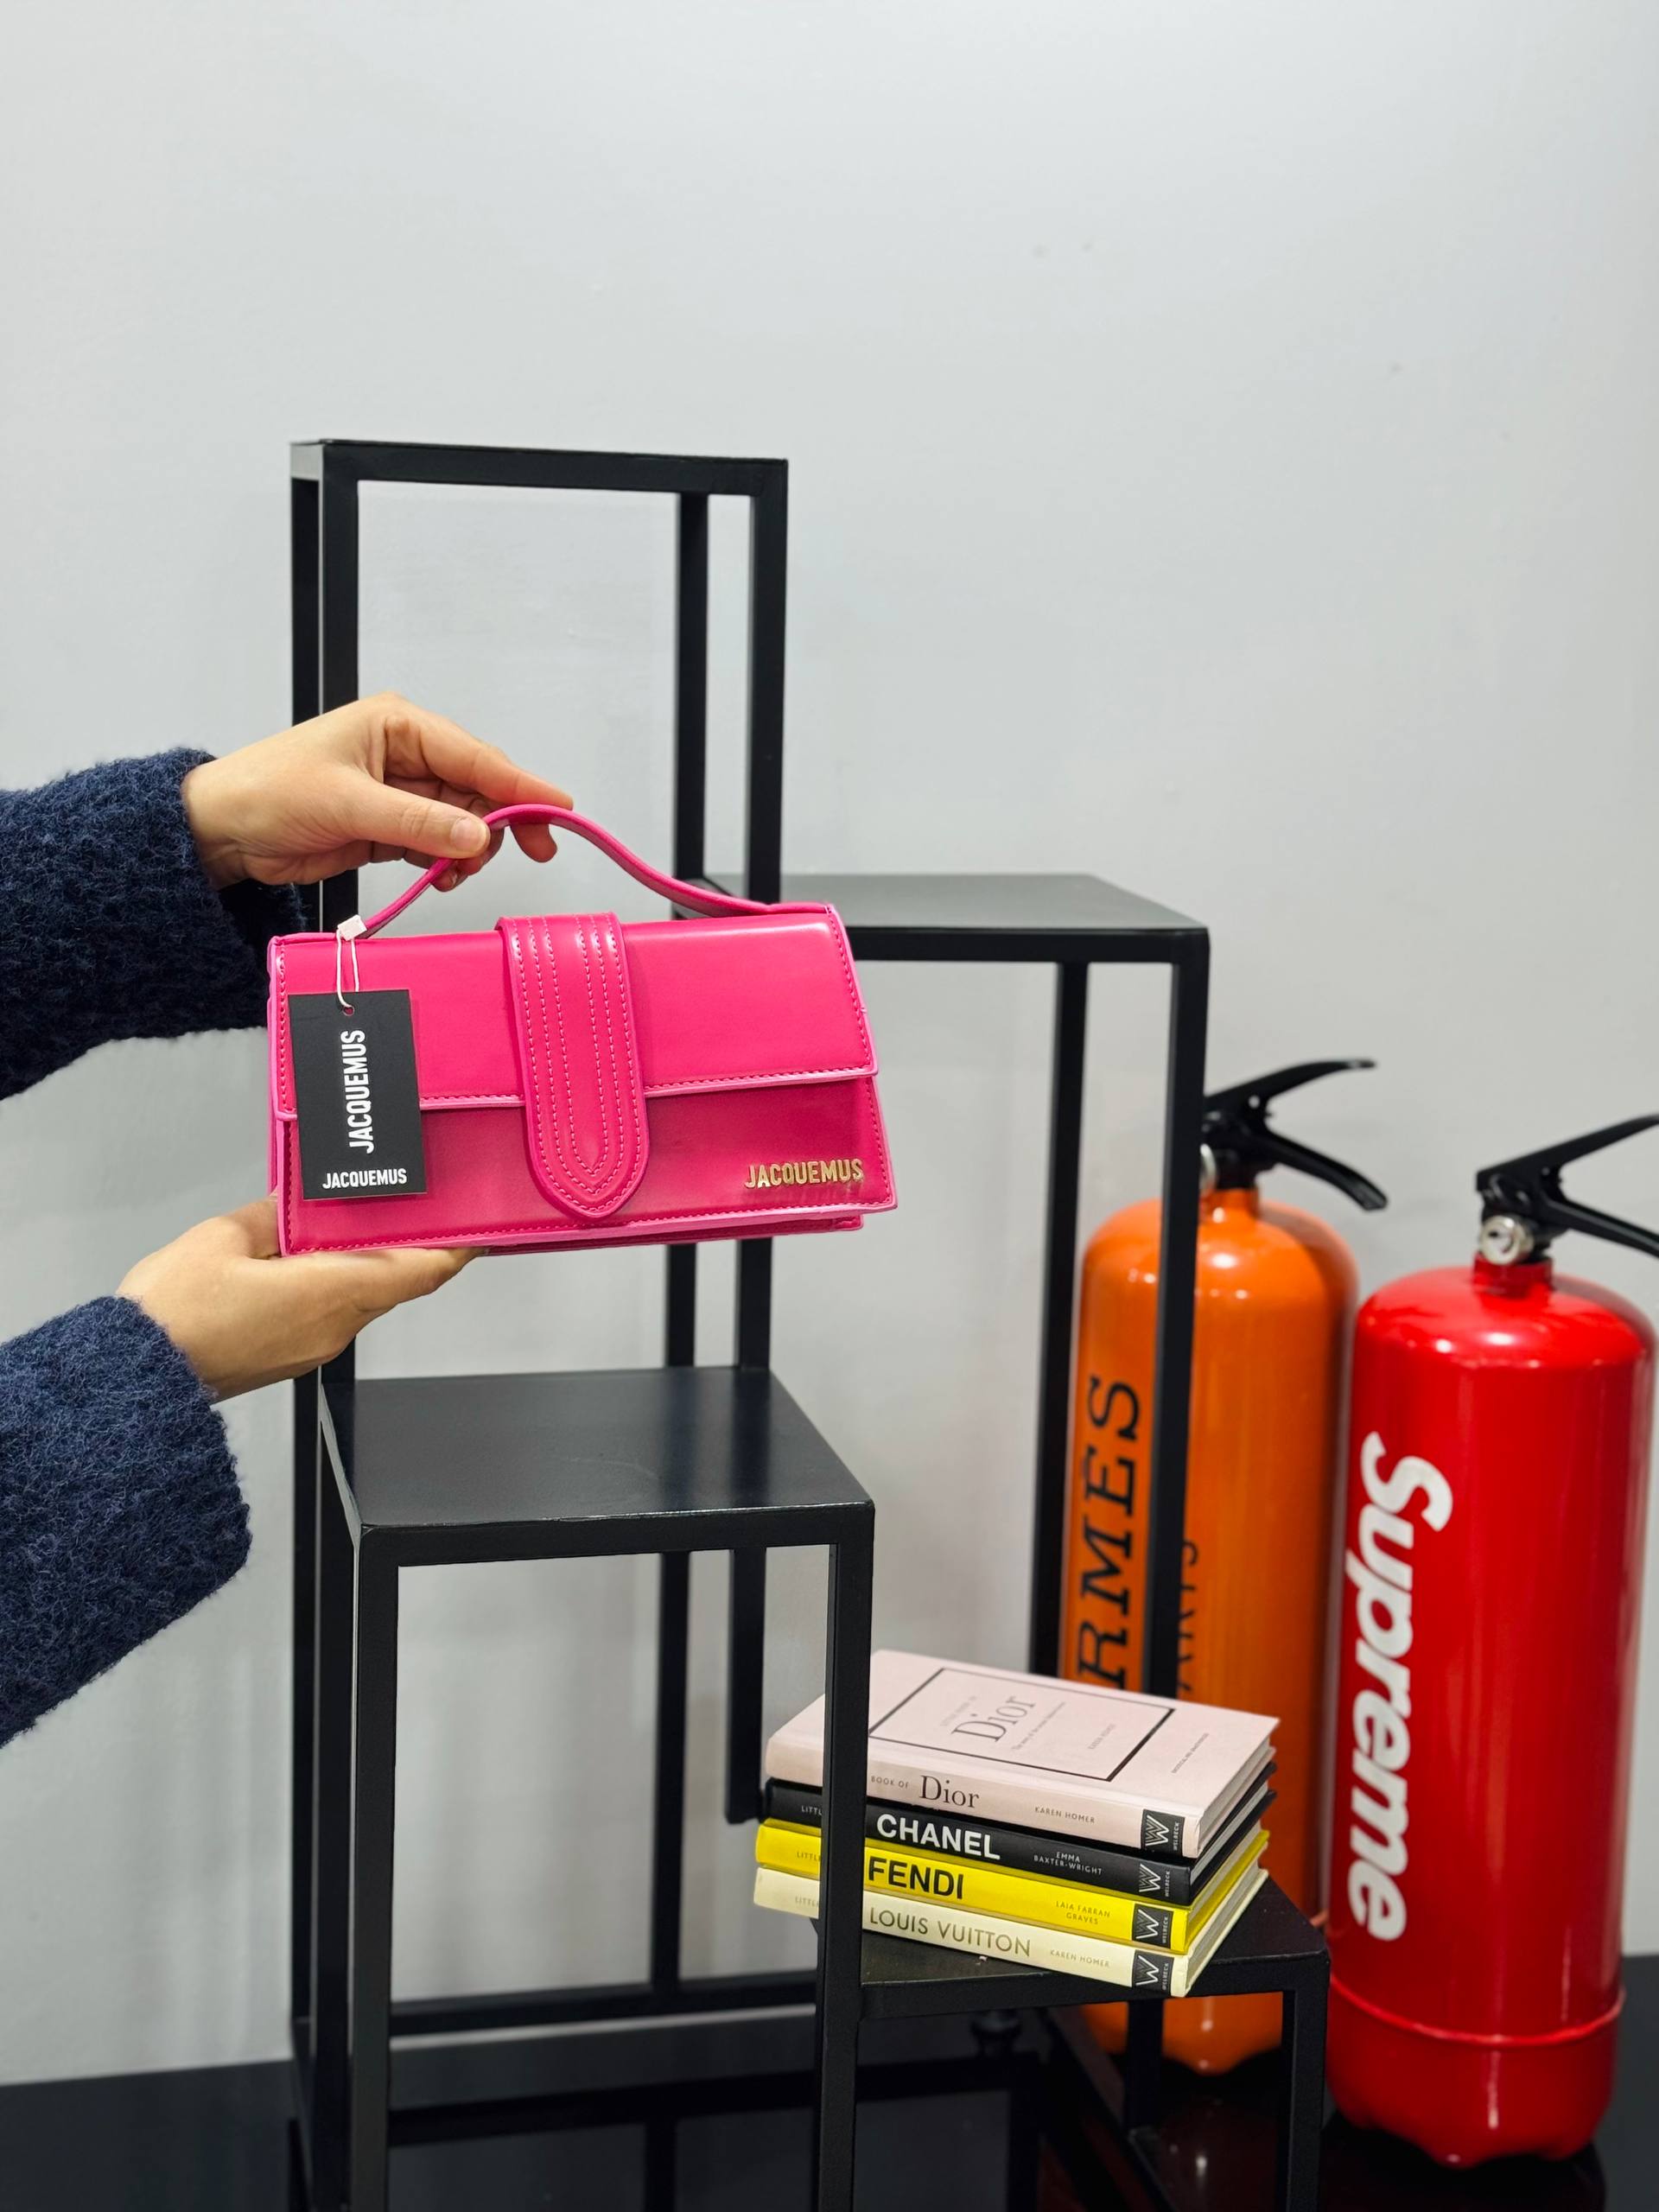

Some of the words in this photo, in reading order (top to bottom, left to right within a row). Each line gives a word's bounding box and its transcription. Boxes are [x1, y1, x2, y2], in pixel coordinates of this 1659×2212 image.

[340, 1029, 375, 1154] JACQUEMUS
[322, 1167, 408, 1190] JACQUEMUS
[744, 1158, 864, 1189] JACQUEMUS
[1344, 1431, 1453, 1942] Supreme
[950, 1695, 1036, 1743] Dior
[871, 1775, 895, 1786] BOOK
[898, 1780, 909, 1789] OF
[918, 1775, 980, 1808] Dior
[1035, 1806, 1062, 1818] KAREN
[1065, 1812, 1096, 1824] HOMER
[876, 1814, 1001, 1860] CHANEL
[1033, 1854, 1103, 1875] BAXTER-WRIGHT
[1056, 1851, 1080, 1863] EMMA
[868, 1855, 964, 1900] FENDI
[1056, 1900, 1076, 1912] LAIA
[1077, 1904, 1111, 1918] FARRAN
[1066, 1911, 1099, 1925] GRAVES
[870, 1907, 928, 1935] LOUIS
[938, 1921, 1031, 1957] VUITTON
[1050, 1948, 1077, 1961] KAREN
[1079, 1955, 1109, 1968] HOMER
